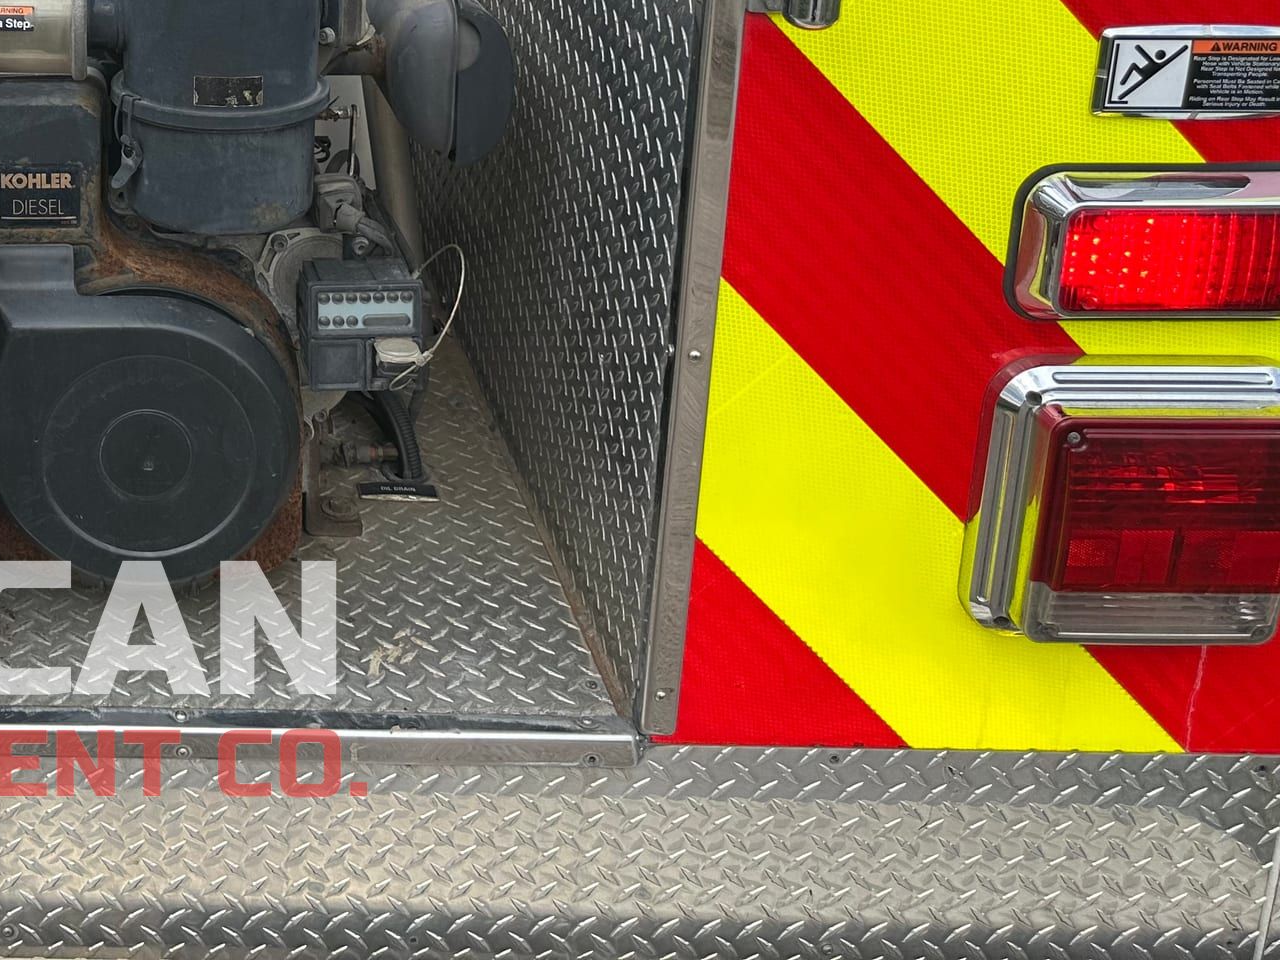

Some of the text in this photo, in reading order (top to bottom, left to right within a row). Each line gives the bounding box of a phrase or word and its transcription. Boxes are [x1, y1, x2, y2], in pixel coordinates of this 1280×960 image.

[5, 18, 31, 31] Step
[1222, 42, 1278, 52] WARNING
[0, 172, 73, 190] KOHLER
[12, 199, 65, 215] DIESEL
